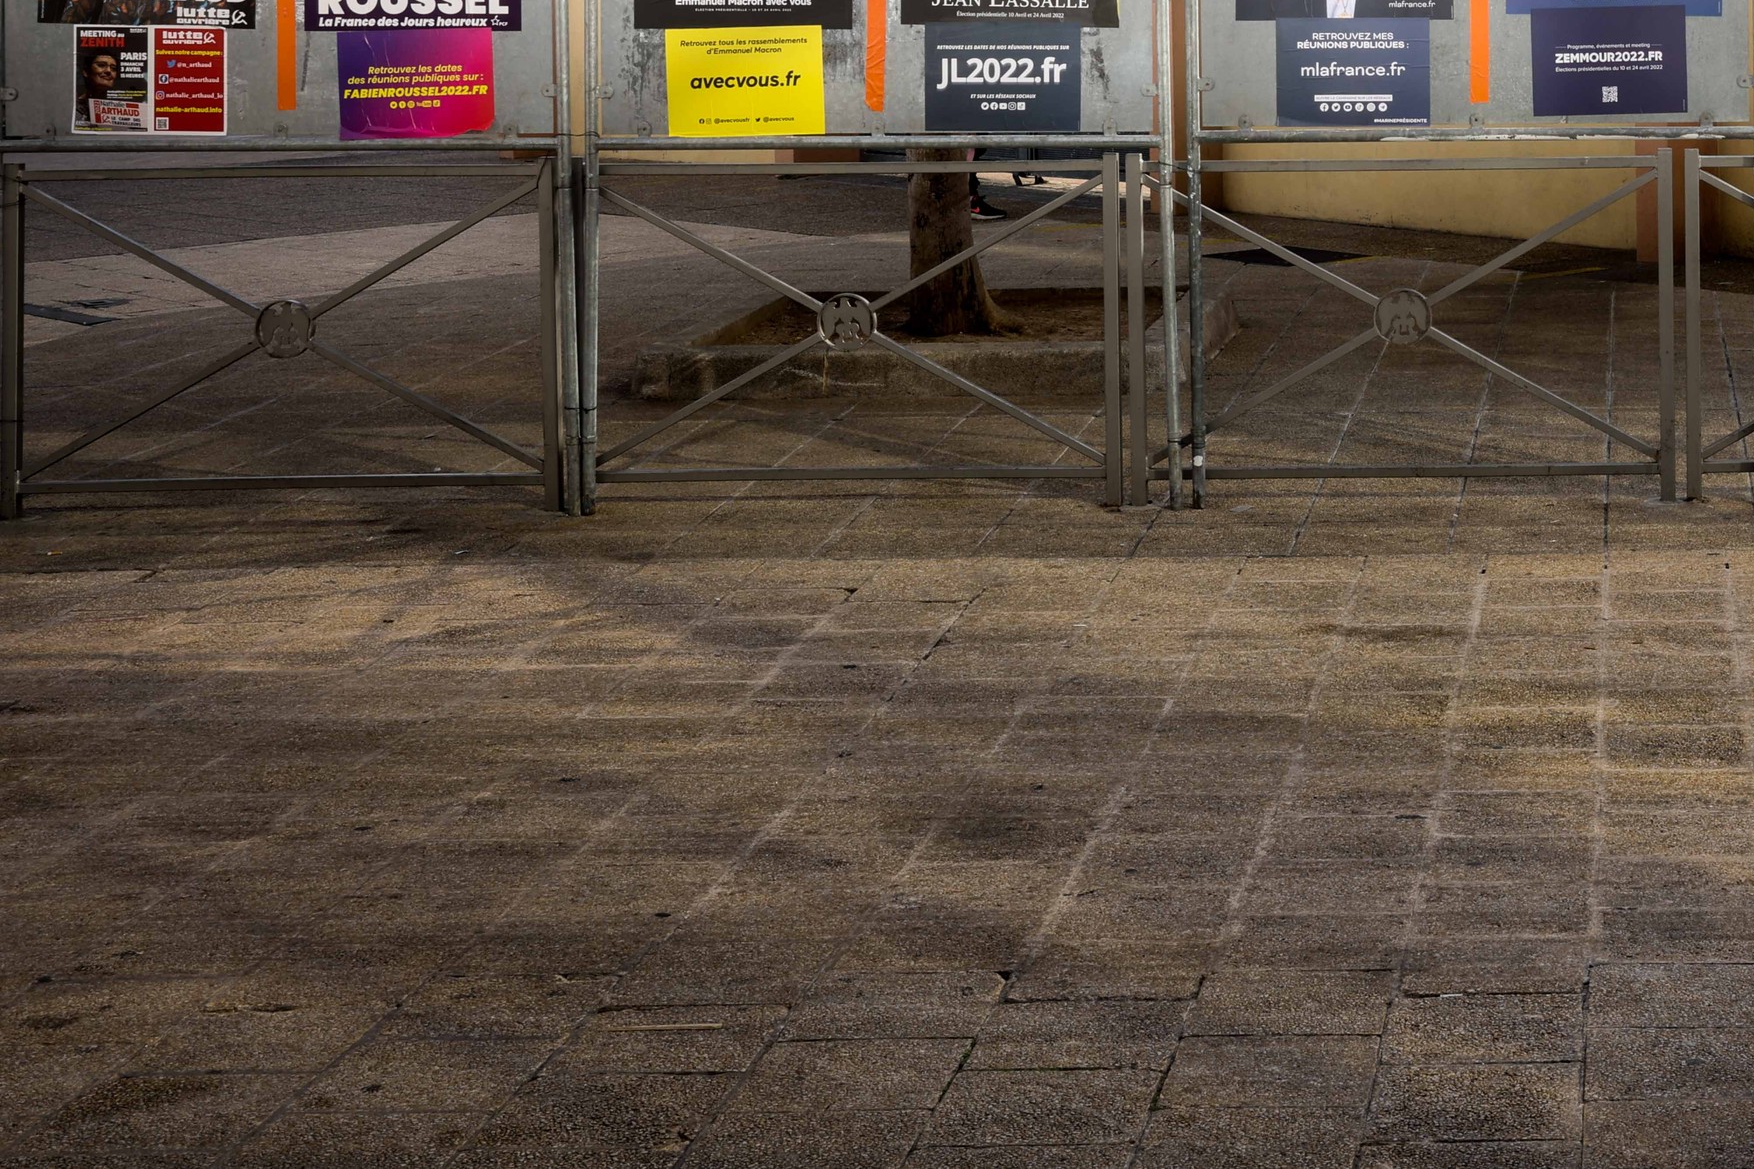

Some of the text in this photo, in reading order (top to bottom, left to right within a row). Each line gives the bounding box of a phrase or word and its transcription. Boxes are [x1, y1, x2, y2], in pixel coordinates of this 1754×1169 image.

[1388, 0, 1436, 8] mlafrance.fr
[319, 17, 487, 27] La France des Jours heureux
[80, 30, 116, 38] MEETING
[80, 38, 125, 47] ZENITH
[680, 39, 716, 47] Retrouvez
[748, 37, 807, 45] rassemblements
[1297, 40, 1404, 49] RÉUNIONS PUBLIQUES
[120, 52, 147, 60] PARIS
[1555, 51, 1663, 63] ZEMMOUR2022.FR
[368, 64, 462, 75] Retrouvez les dates
[936, 57, 1067, 90] JL2022.fr
[1300, 62, 1406, 77] mlafrance.fr
[348, 73, 479, 84] des réunions publiques sur
[690, 70, 801, 90] avecvous.fr
[344, 85, 488, 99] FABIENROUSSEL2022.FR
[100, 107, 139, 117] ARTHAUD
